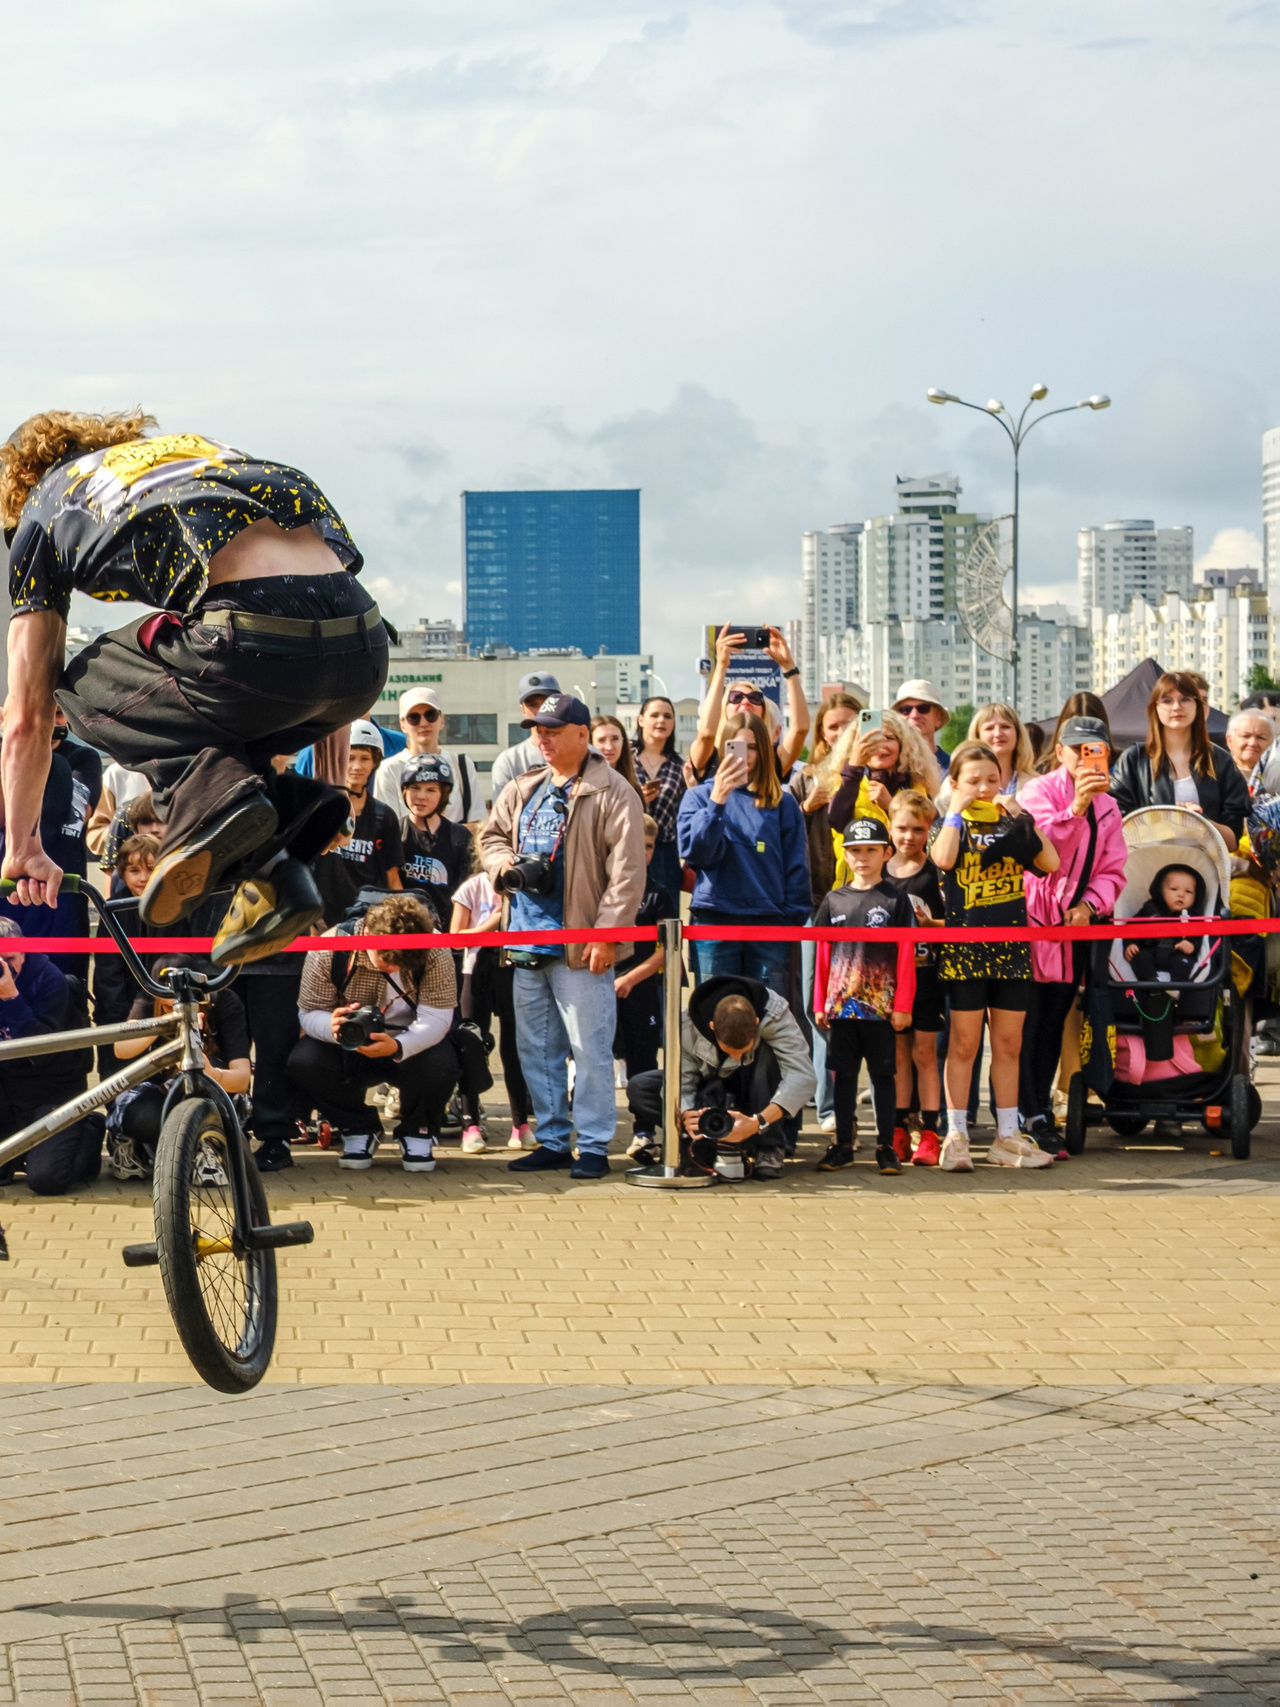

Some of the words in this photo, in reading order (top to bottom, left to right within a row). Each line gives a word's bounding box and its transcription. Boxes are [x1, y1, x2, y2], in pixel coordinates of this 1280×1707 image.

[341, 838, 374, 856] ENTS
[414, 854, 433, 865] THE
[969, 874, 1024, 903] FEST
[79, 1075, 130, 1113] GORILLA
